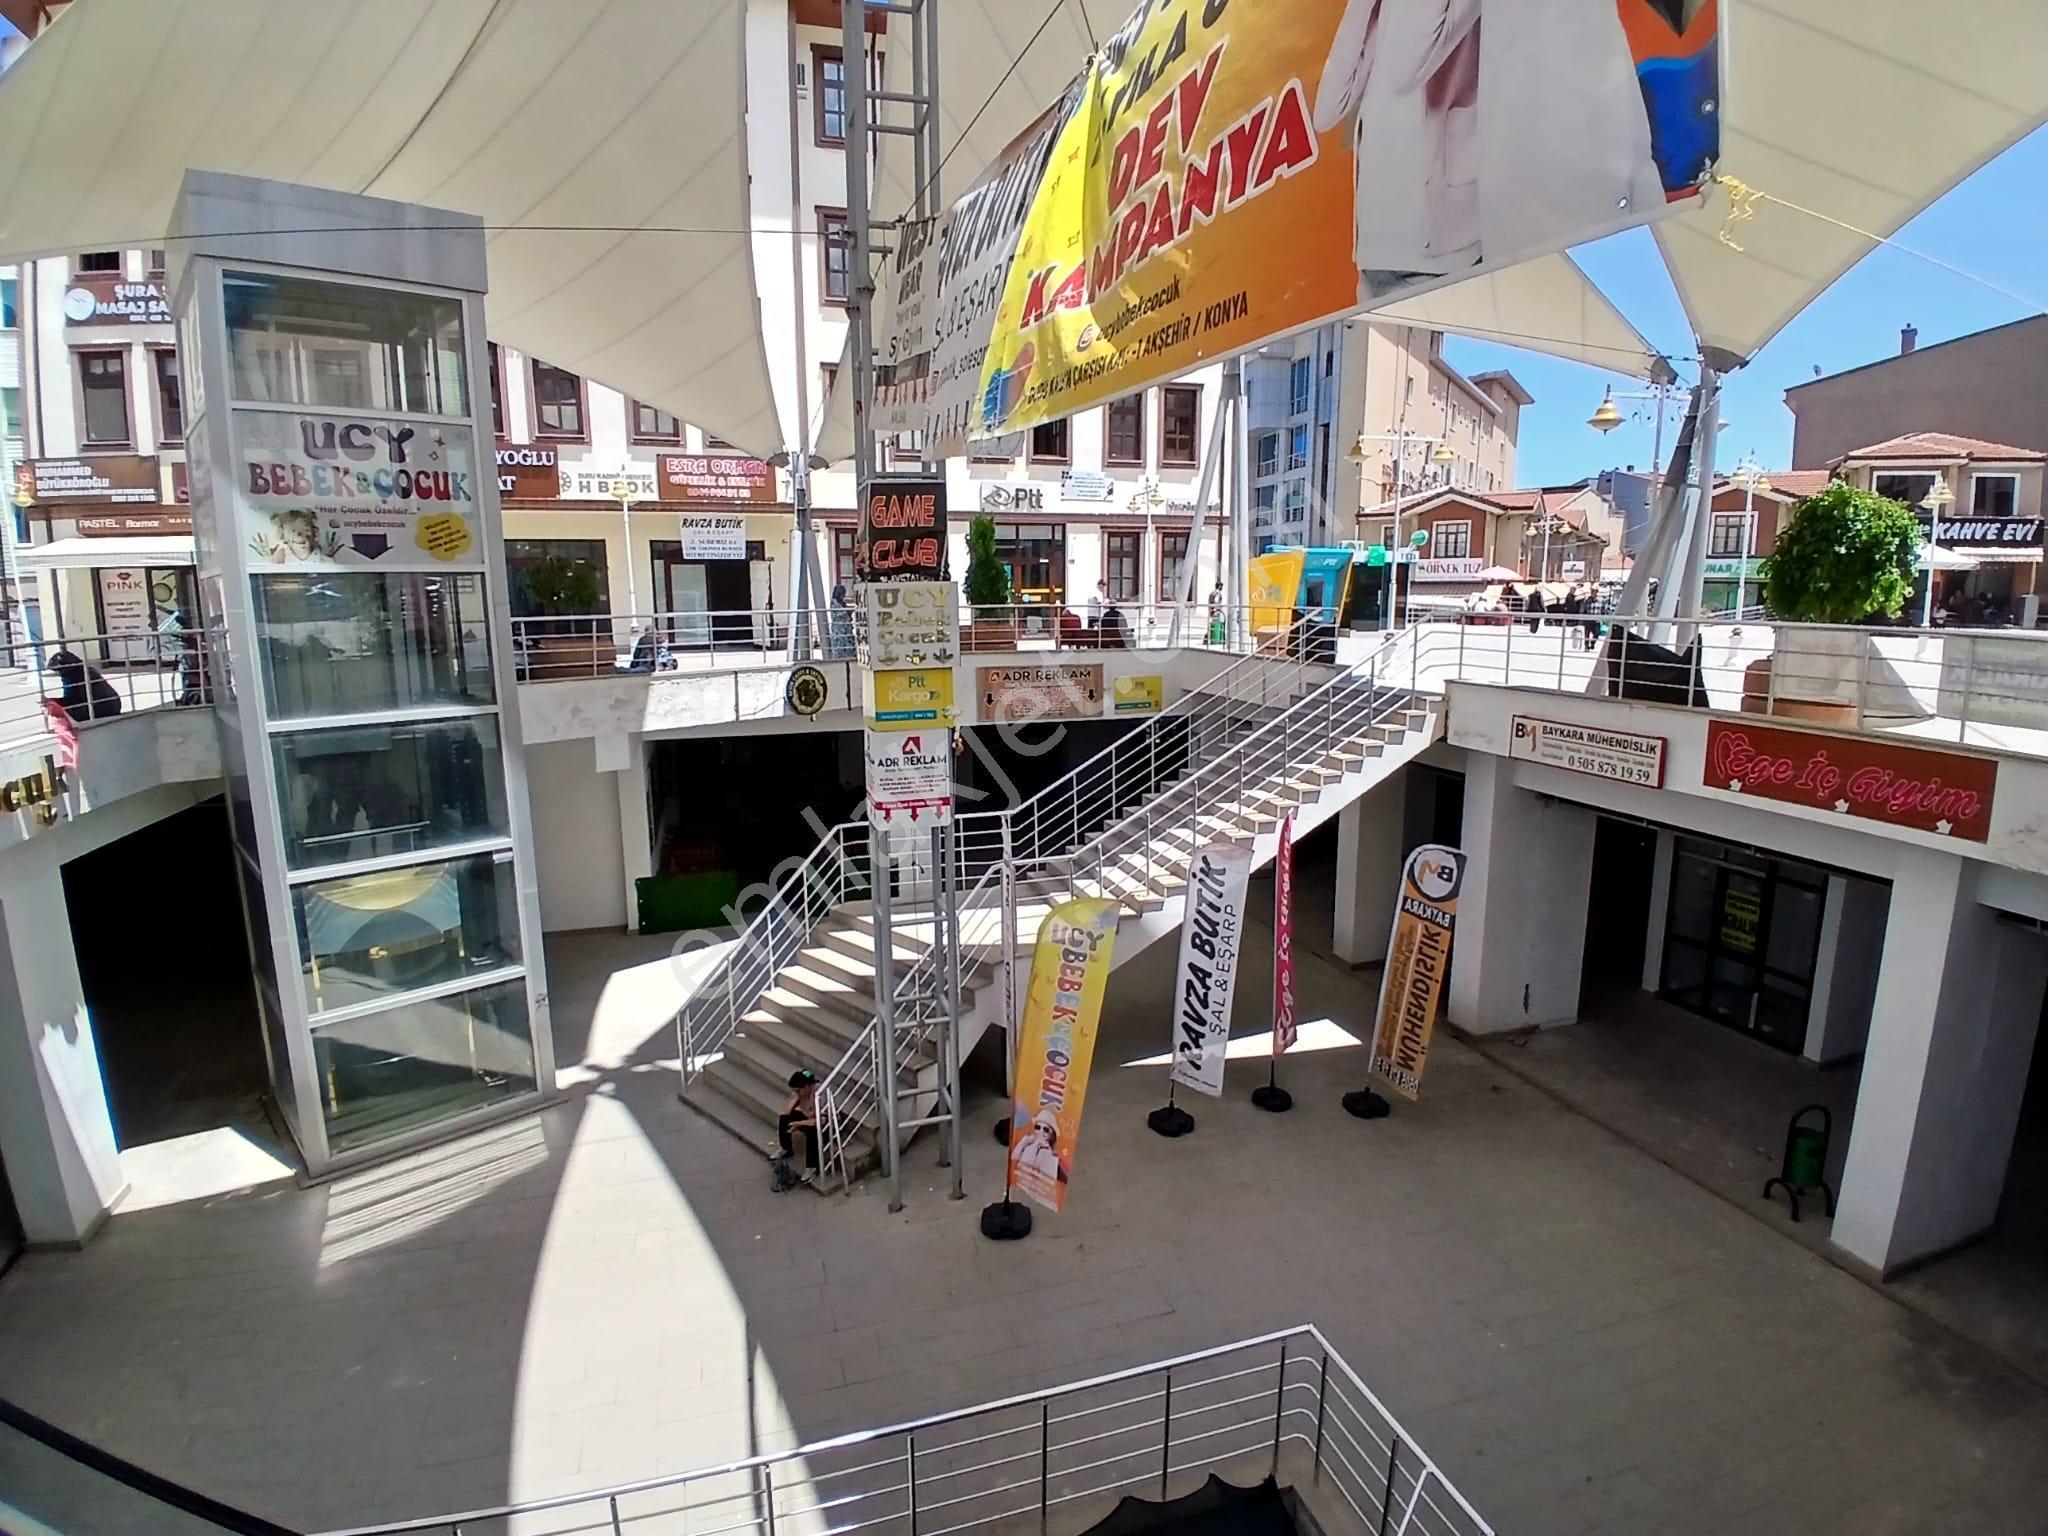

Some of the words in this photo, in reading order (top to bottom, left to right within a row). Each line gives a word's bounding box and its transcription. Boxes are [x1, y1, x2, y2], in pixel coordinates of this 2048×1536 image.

[1108, 42, 1227, 217] DEV
[1018, 82, 1317, 331] KAMPANYA
[114, 284, 160, 300] ŞURA
[96, 301, 146, 314] MASAJ
[1143, 312, 1190, 357] AKŞEHİR
[1203, 290, 1249, 332] KONYA
[299, 420, 416, 464] UCY
[666, 457, 707, 475] ESRA
[711, 458, 768, 476] ORHAN
[1013, 487, 1044, 510] Ptt
[681, 518, 713, 529] RAVZA
[714, 516, 744, 529] BUTİK
[870, 494, 936, 529] GAME
[79, 518, 120, 529] PASTEL
[1936, 521, 2001, 541] KAHVE
[2002, 519, 2040, 541] EVİ
[871, 537, 939, 569] CLUB
[1425, 561, 1459, 574] ÖRNEK
[106, 581, 143, 591] PINK
[874, 587, 951, 609] UCY
[908, 675, 926, 689] Ptt
[1003, 670, 1031, 681] ADR
[1036, 669, 1091, 681] REKLAM
[1541, 725, 1585, 742] BAYKARA
[1586, 731, 1658, 755] MÜHENDİSLİK
[877, 757, 900, 768] ADR
[903, 753, 948, 767] REKLAM
[1567, 755, 1575, 767] 0
[1577, 756, 1595, 770] 505
[1597, 759, 1618, 776] 878
[1620, 766, 1634, 780] 19
[1636, 769, 1650, 783] 59
[1727, 745, 1795, 786] Ege
[1796, 750, 1841, 799] İç
[1846, 766, 1981, 819] Giyim
[1190, 855, 1227, 961] BUTİK
[1216, 903, 1237, 973] EŞARP
[1214, 978, 1228, 993] &
[1179, 960, 1213, 1072] RAVZA
[1209, 999, 1227, 1036] ŞAL
